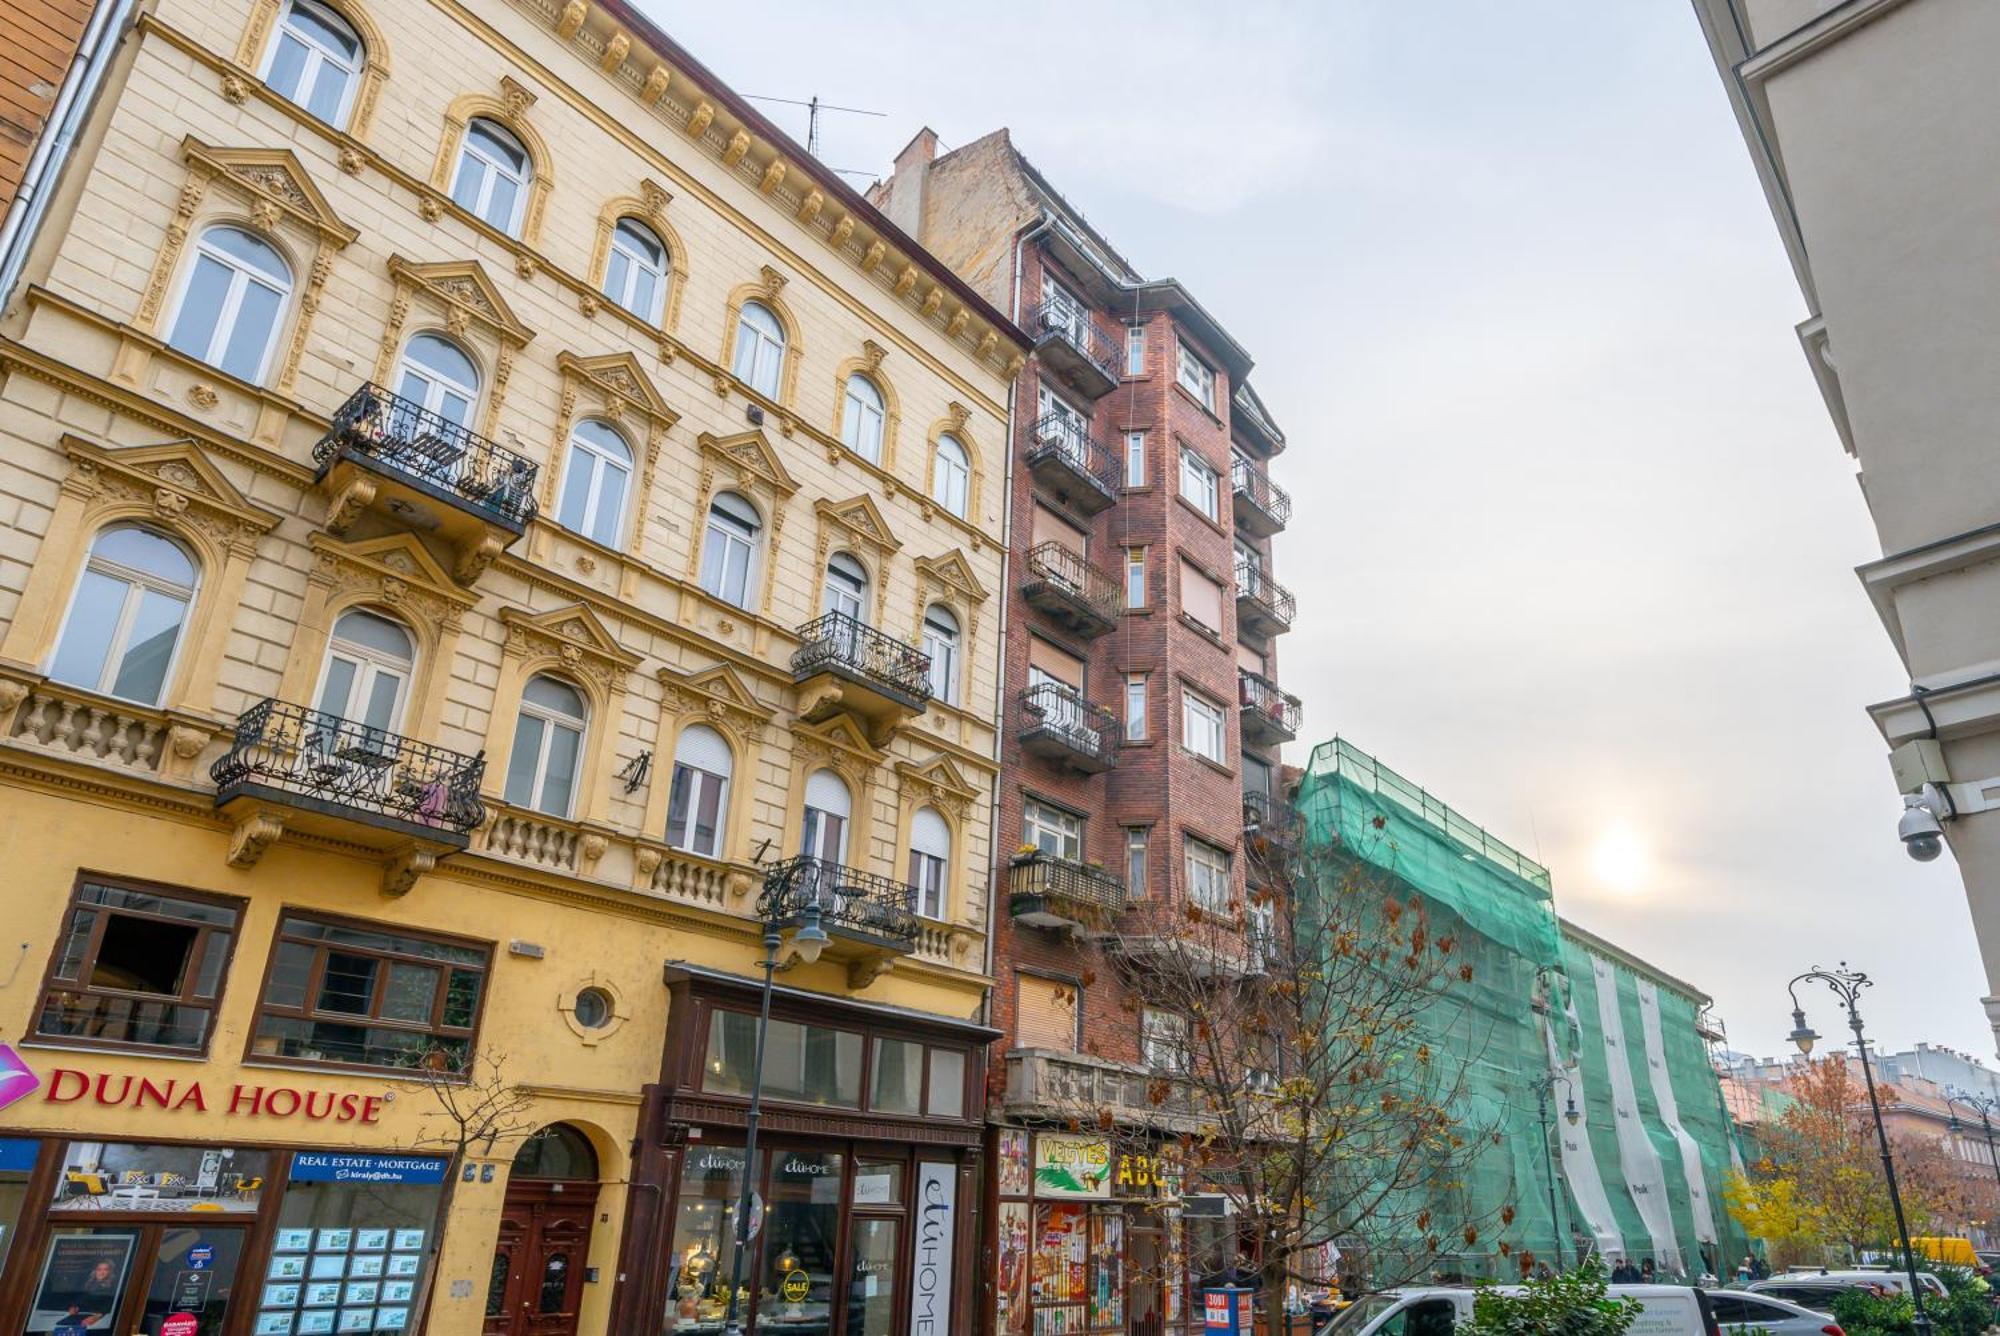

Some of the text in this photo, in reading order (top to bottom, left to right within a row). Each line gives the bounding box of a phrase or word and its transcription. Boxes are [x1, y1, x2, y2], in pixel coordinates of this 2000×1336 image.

[45, 1068, 384, 1124] DUNA HOUSE
[299, 1156, 441, 1171] REAL ESTATE MORTGAGE
[787, 1282, 807, 1292] SALE
